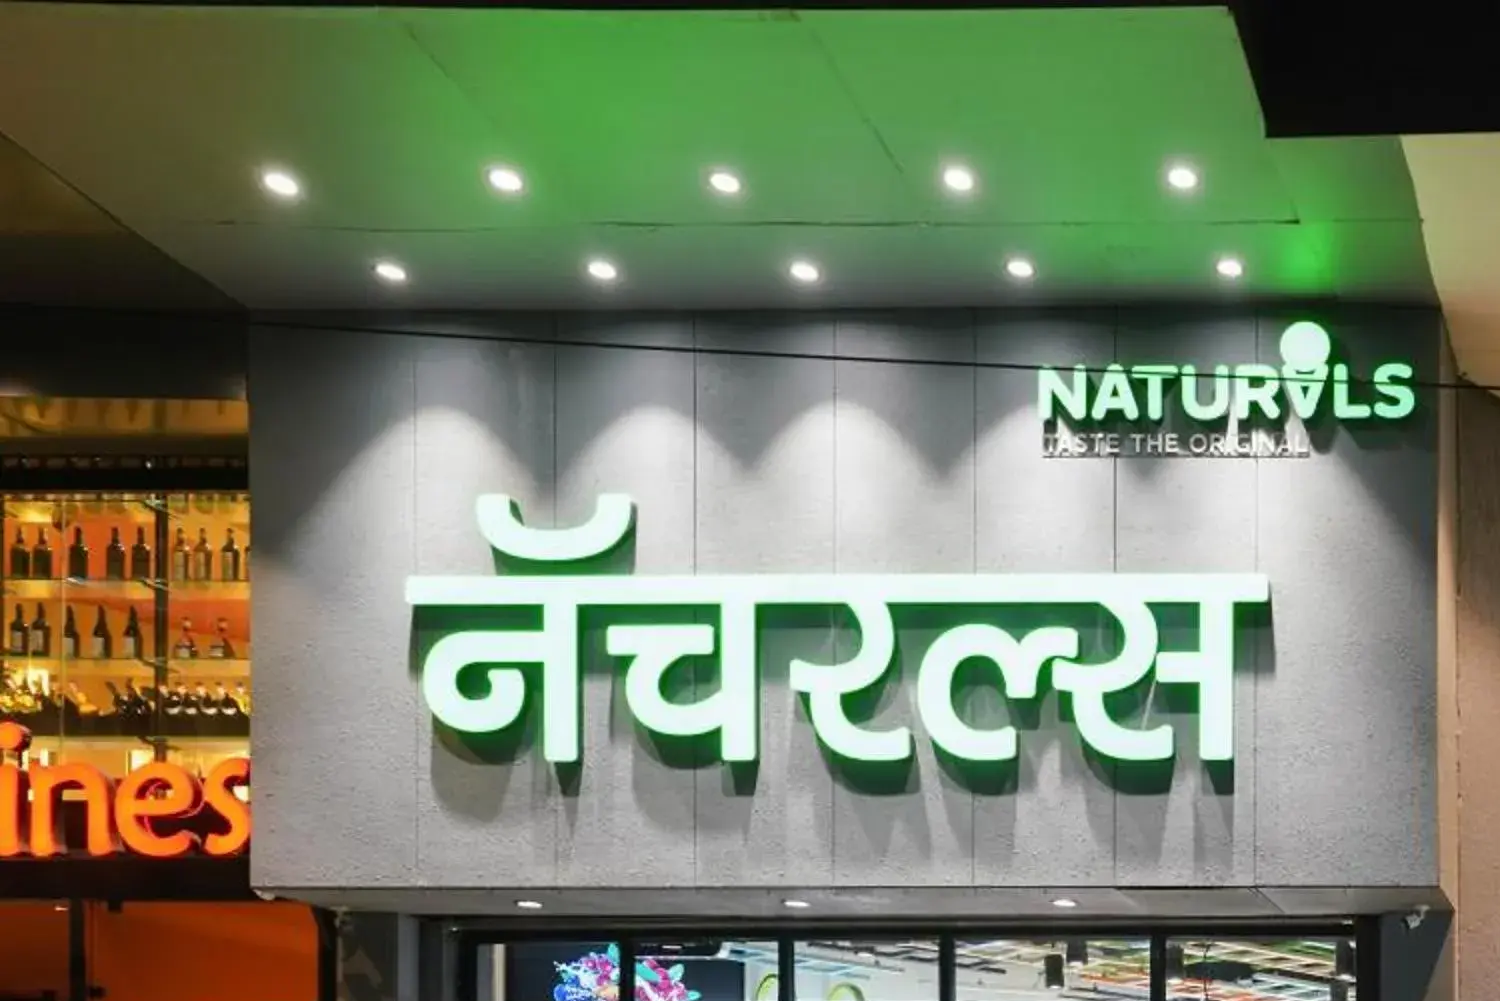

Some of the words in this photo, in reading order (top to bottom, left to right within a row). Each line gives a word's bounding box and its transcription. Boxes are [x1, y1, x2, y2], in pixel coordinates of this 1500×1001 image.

[1037, 321, 1415, 421] NATURALS
[1044, 433, 1119, 455] TASTE
[1130, 433, 1179, 454] THE
